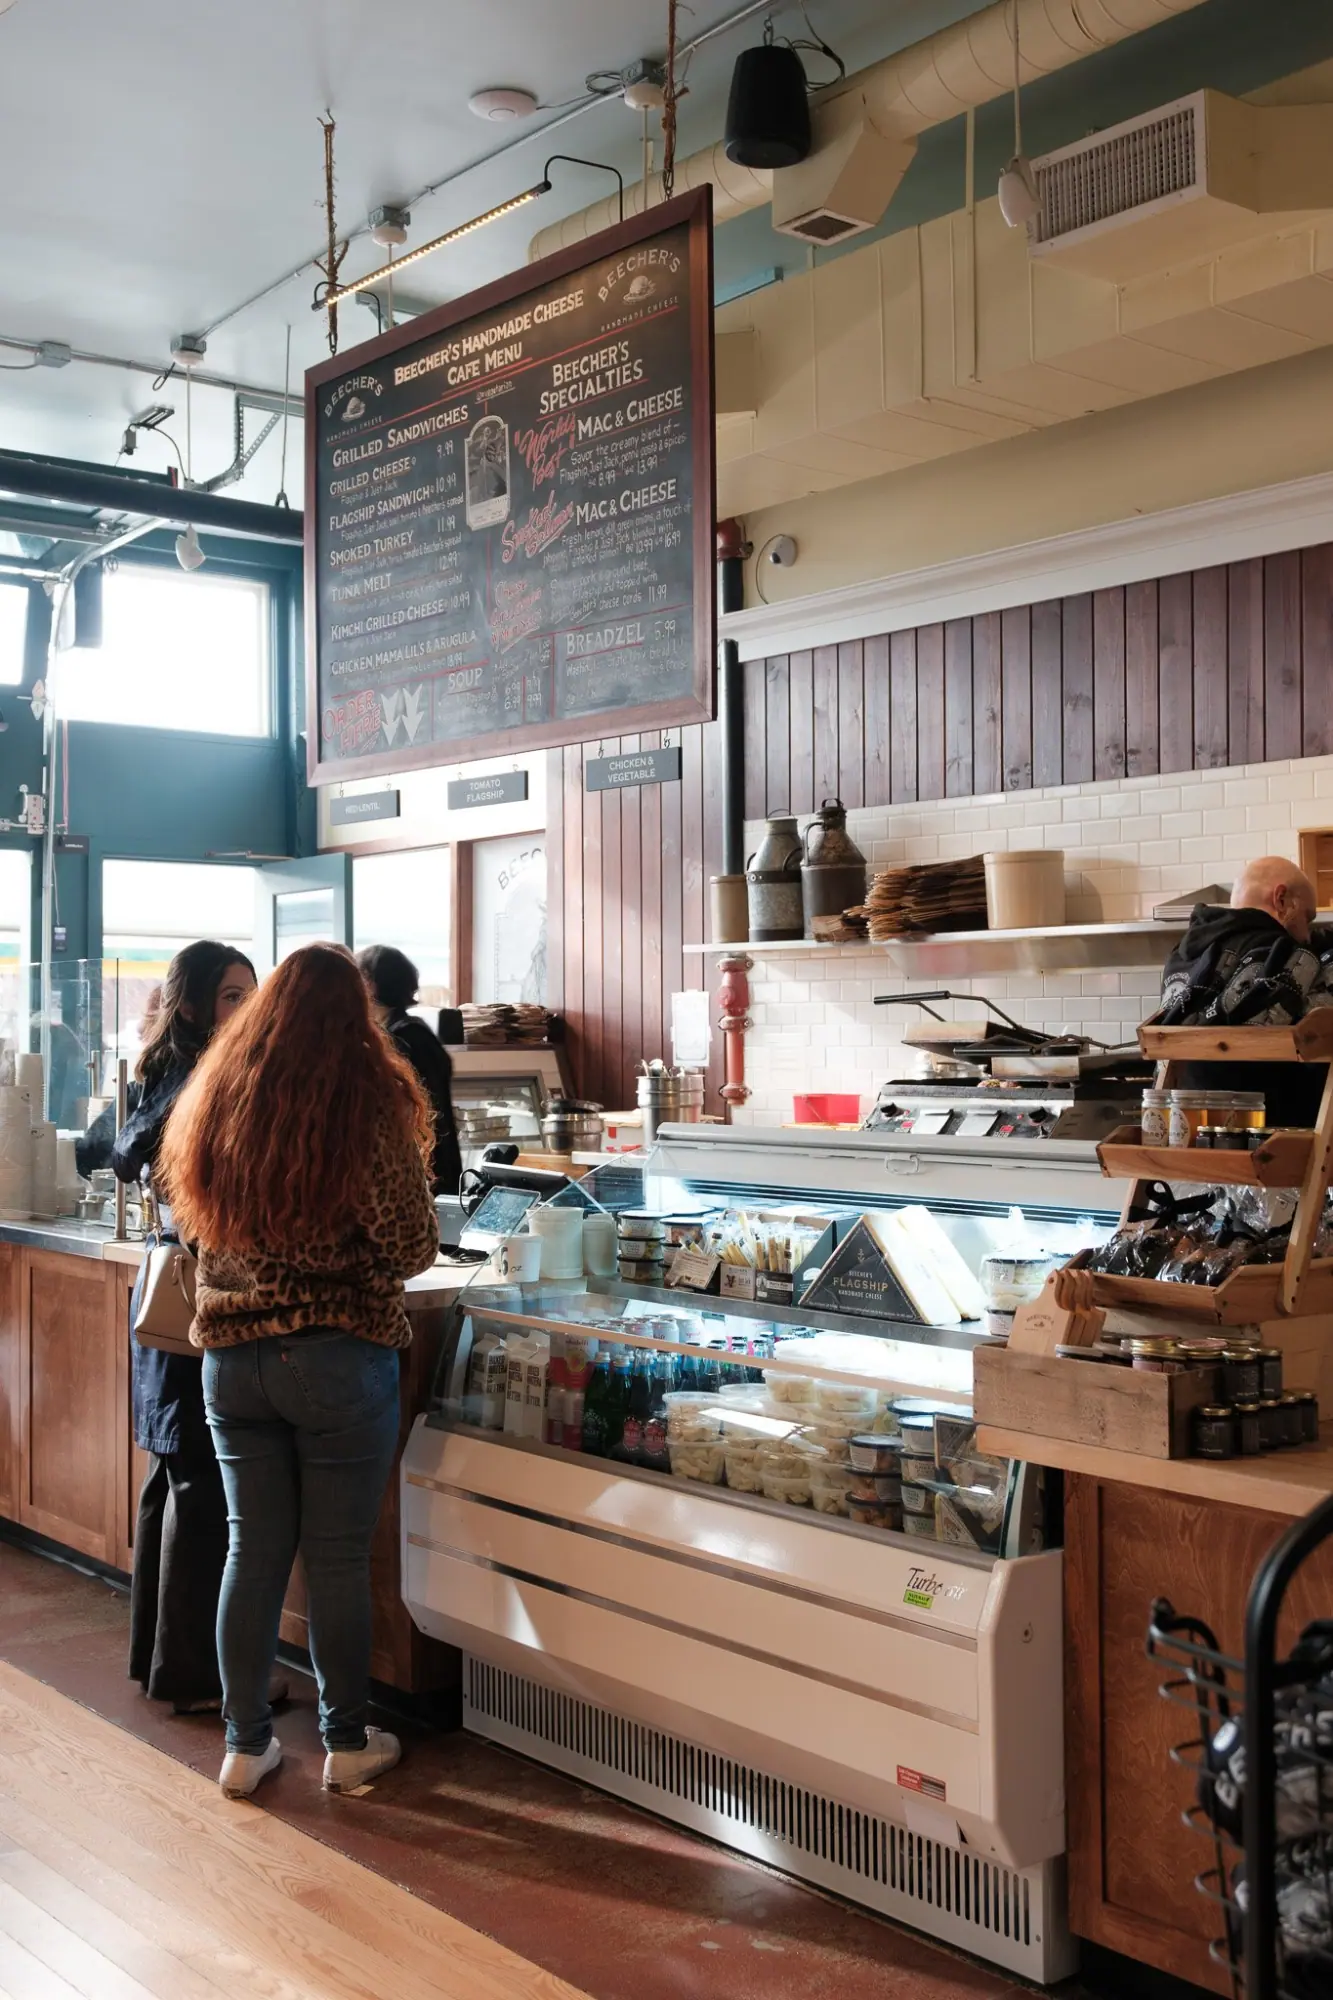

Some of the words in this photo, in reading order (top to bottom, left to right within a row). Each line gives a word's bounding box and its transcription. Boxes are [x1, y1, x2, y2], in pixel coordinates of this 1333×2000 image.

[598, 249, 681, 302] BEECHER'S
[394, 343, 460, 386] BEECHER'S
[462, 312, 532, 357] HANDMADE
[533, 289, 584, 324] CHEESE
[447, 359, 481, 385] CAFE
[484, 342, 522, 372] MENU
[552, 341, 629, 387] BEECHER'S
[324, 376, 384, 418] BEECHER'S
[540, 359, 644, 415] SPECIALTIES
[577, 412, 613, 441] MAC
[614, 411, 624, 428] &
[626, 387, 683, 422] CHEESE
[332, 439, 383, 467] GRILLED
[387, 404, 469, 449] SANDWICHES
[570, 450, 593, 466] Savor
[596, 444, 609, 456] the
[610, 435, 640, 453] creamy
[329, 472, 370, 496] GRILLED
[372, 456, 412, 481] CHEESE
[329, 504, 376, 531] FLAGSHIP
[377, 484, 430, 516] SANDWICH
[576, 501, 608, 526] MAC
[609, 498, 618, 517] &
[619, 479, 677, 512] CHEESE
[330, 542, 371, 568] SMOKED
[373, 530, 414, 554] TURKEY
[332, 583, 361, 603] TUNA
[363, 572, 392, 595] MELT
[331, 621, 364, 642] KIMCHI
[365, 610, 405, 632] GRILLED
[406, 599, 445, 622] CHEESE
[375, 647, 404, 668] MAMA
[433, 630, 477, 652] ARUGULA
[448, 667, 484, 692] SOUP
[564, 621, 646, 657] BREADZEL
[469, 779, 501, 791] TOMATO
[607, 768, 657, 783] VEGETABLE
[609, 759, 645, 772] CHICKEN
[647, 756, 655, 766] &
[466, 789, 505, 803] FLAGSHIP
[833, 1277, 889, 1294] FLAGSHIP
[865, 1291, 883, 1301] CHEESE
